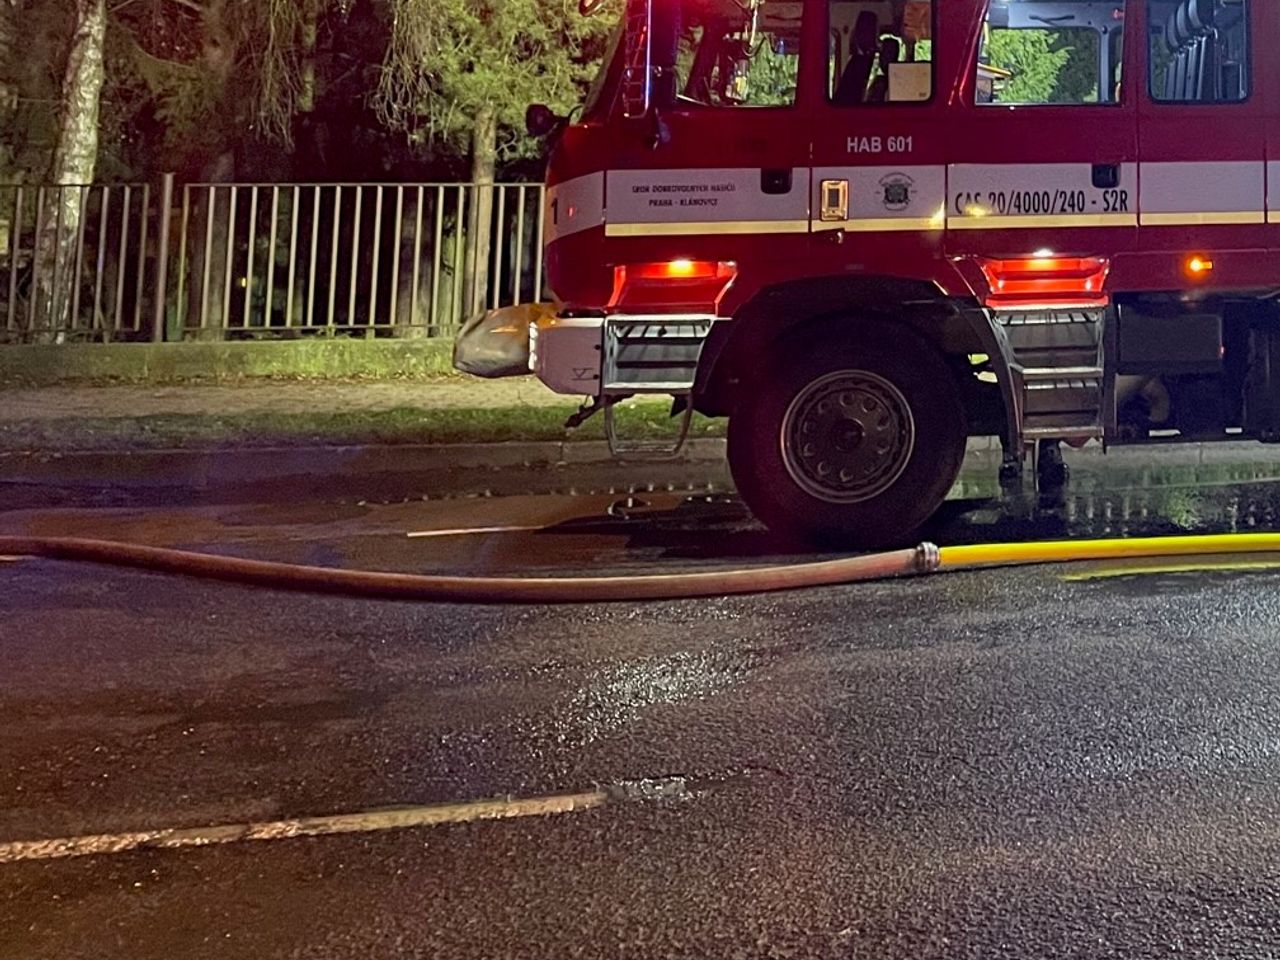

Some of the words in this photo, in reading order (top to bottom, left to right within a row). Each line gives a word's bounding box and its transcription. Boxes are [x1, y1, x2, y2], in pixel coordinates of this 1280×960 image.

[847, 136, 882, 153] HAB
[887, 136, 912, 152] 601
[988, 189, 1085, 215] 20/4000/240
[1103, 190, 1128, 212] S2R
